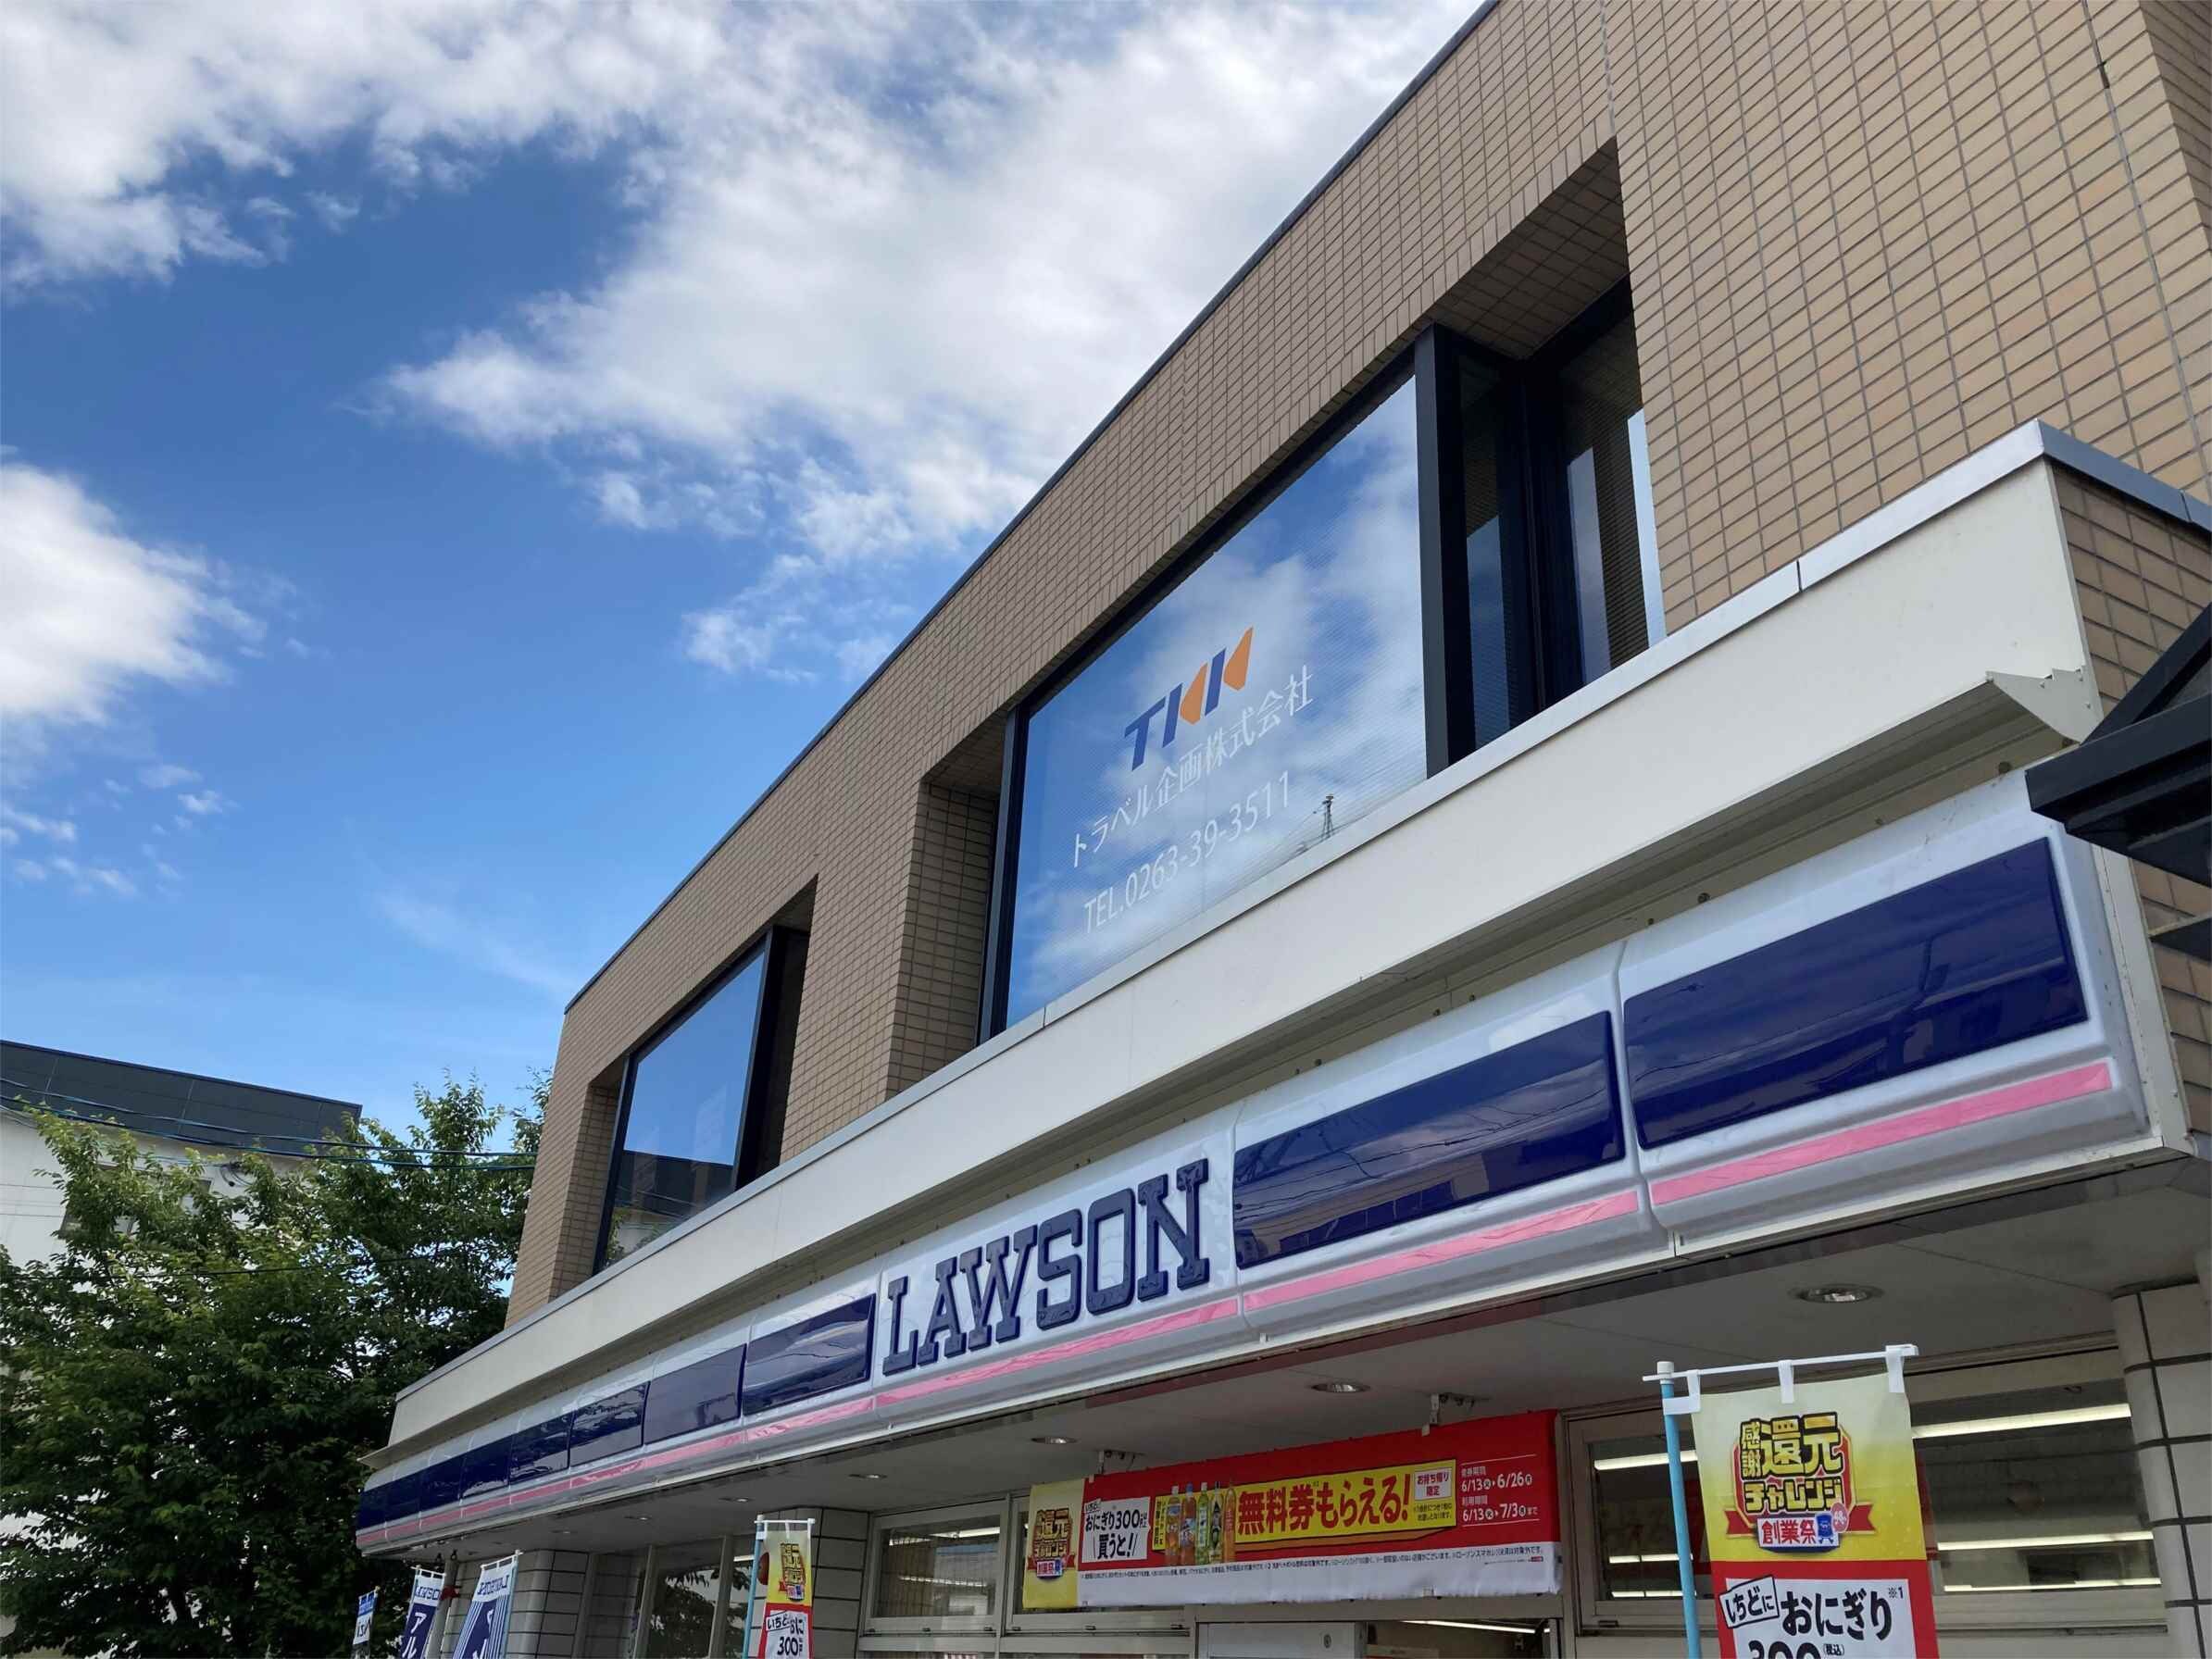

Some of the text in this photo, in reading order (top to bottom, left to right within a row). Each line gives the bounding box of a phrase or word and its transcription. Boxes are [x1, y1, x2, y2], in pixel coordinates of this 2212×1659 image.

[1124, 626, 1254, 772] TKK
[1072, 664, 1315, 868] トラベル企画株式会社
[1083, 770, 1290, 933] TEL.0263-39-3511
[881, 1157, 1210, 1377] LAWSON
[1740, 1420, 1761, 1480] 感謝
[1759, 1412, 1843, 1477] 還元
[1238, 1473, 1411, 1535] 無料券もらえる!
[1743, 1476, 1845, 1513] チャレンジ
[1760, 1518, 1817, 1545] 創業祭
[1724, 1585, 1776, 1624] いちどに
[1780, 1587, 1893, 1641] おにぎり
